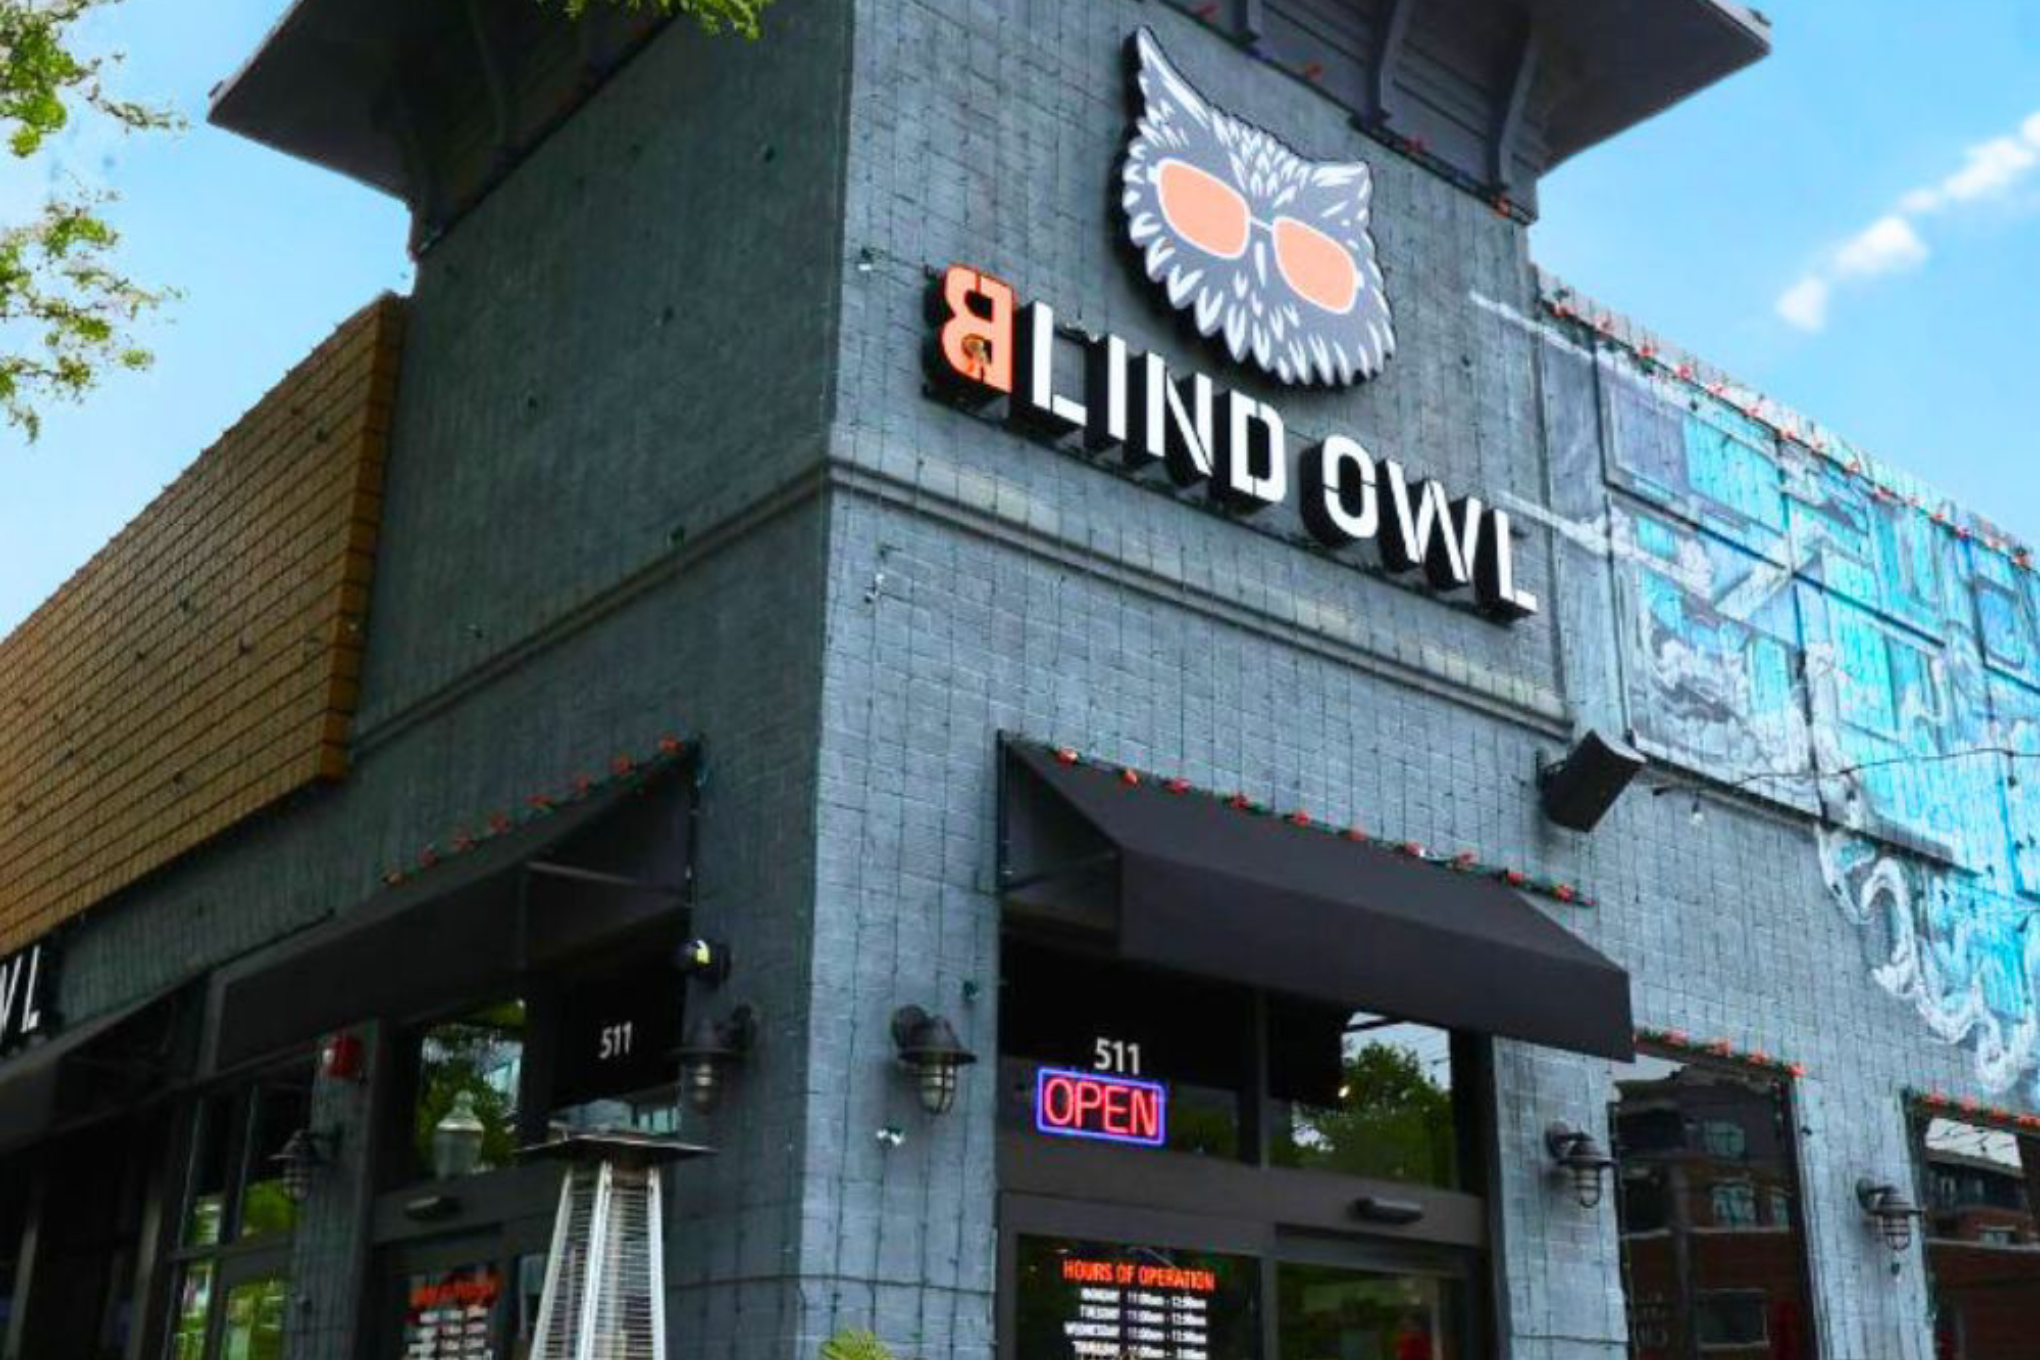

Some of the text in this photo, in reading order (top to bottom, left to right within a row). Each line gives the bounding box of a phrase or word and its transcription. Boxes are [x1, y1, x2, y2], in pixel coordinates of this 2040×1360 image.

[941, 263, 1537, 614] BLIND OWL
[599, 1020, 632, 1059] 511
[1094, 1037, 1140, 1075] 511
[1043, 1077, 1158, 1137] OPEN
[1063, 1259, 1215, 1291] HOURS OF OPERATION
